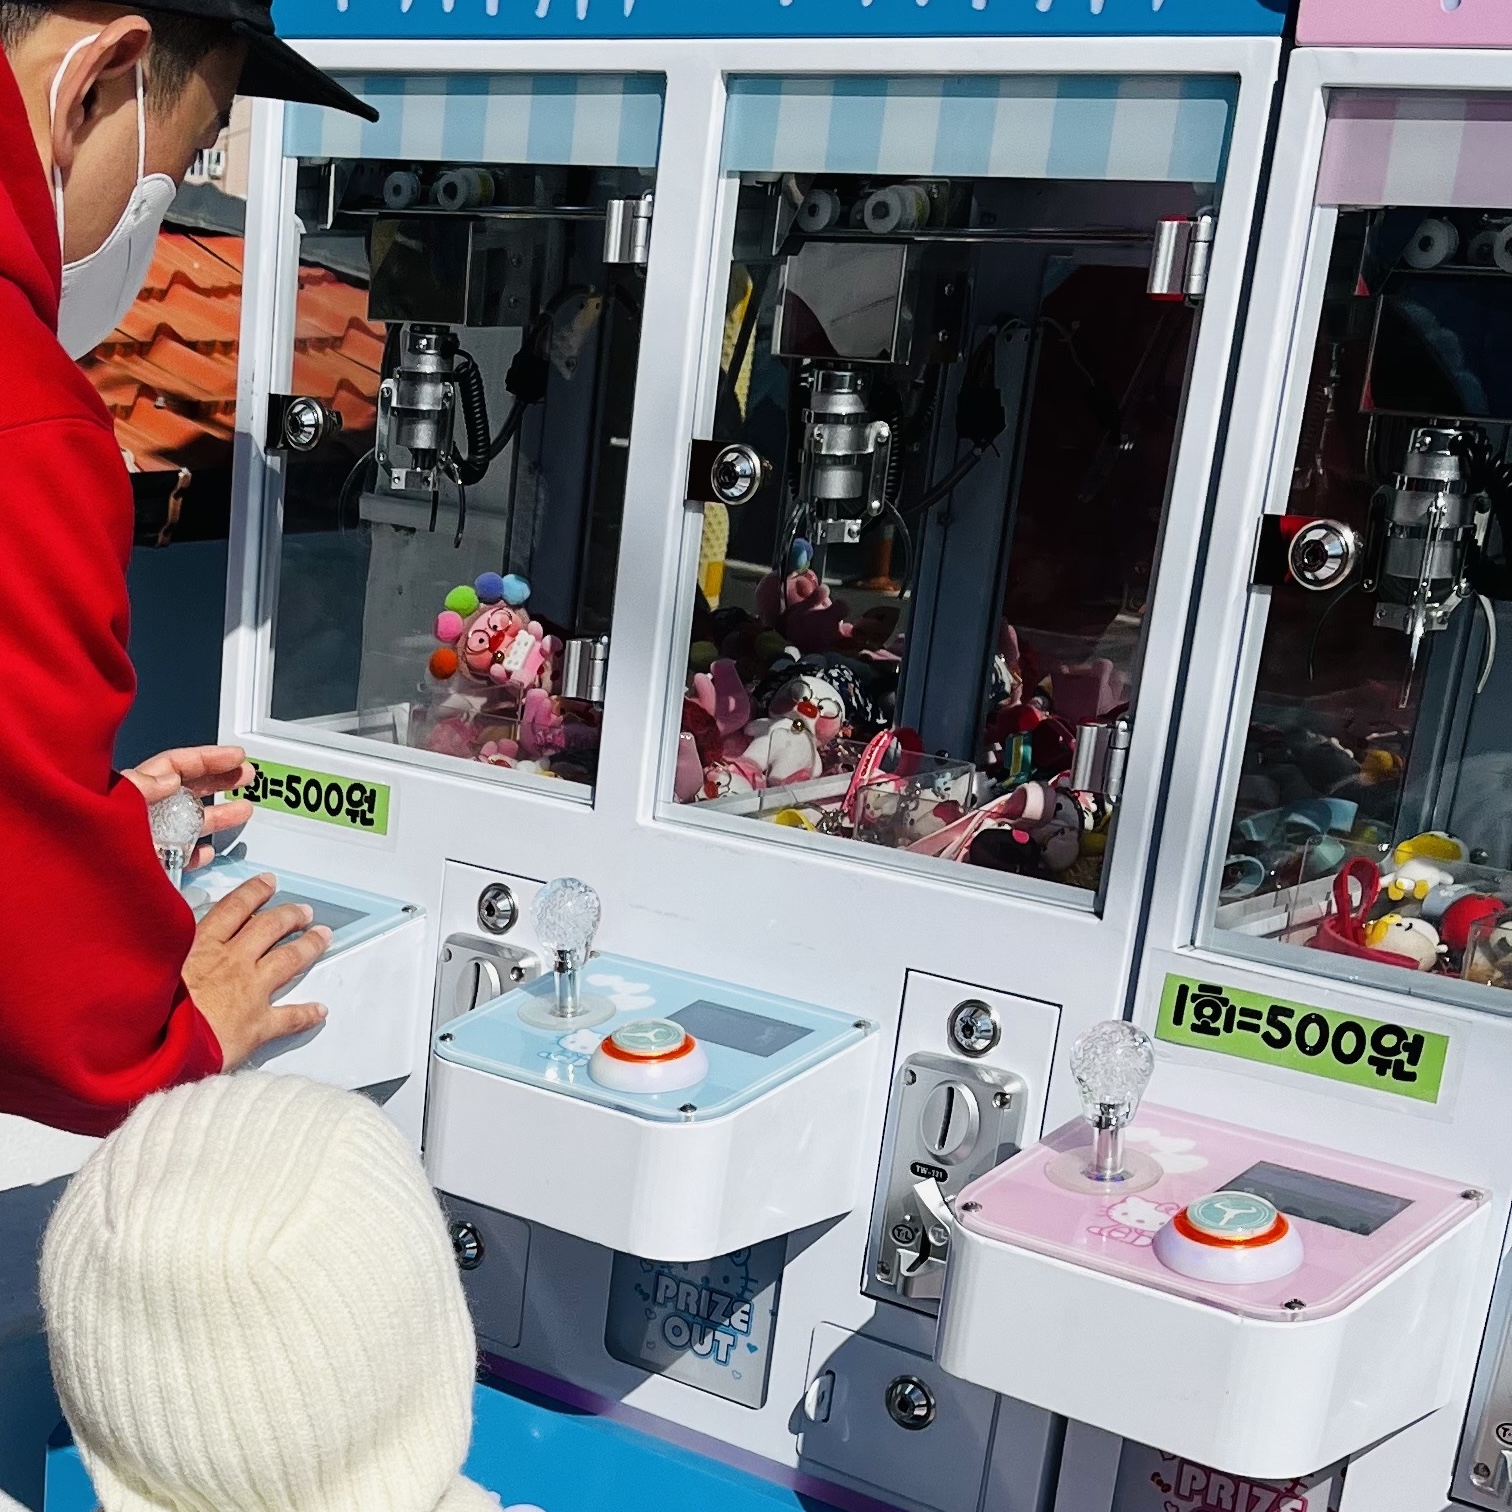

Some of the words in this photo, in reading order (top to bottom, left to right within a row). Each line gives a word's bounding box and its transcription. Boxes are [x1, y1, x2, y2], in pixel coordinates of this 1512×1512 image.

[232, 762, 377, 826] 회=500원
[654, 1273, 753, 1335] PRIZE
[663, 1315, 735, 1364] OUT
